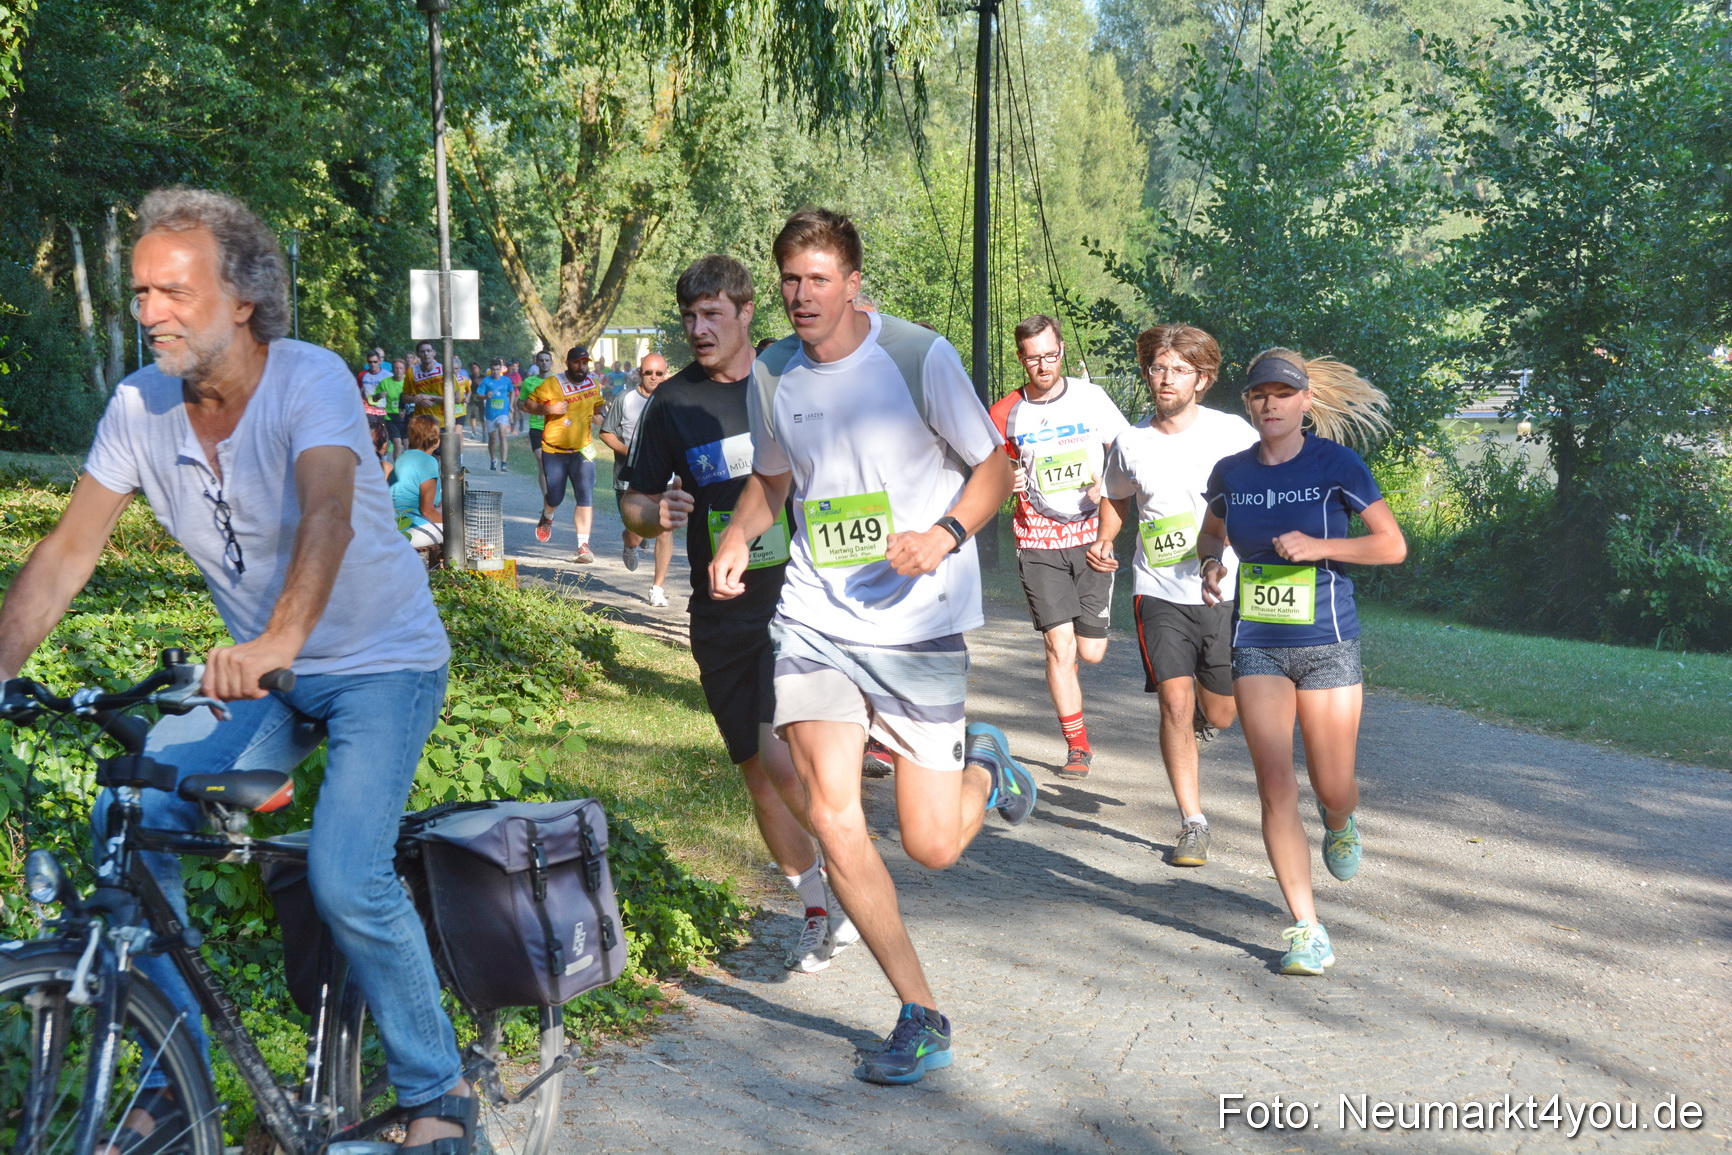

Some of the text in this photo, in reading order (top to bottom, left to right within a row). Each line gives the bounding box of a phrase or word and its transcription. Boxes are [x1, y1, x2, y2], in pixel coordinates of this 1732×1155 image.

[1045, 463, 1082, 483] 1747
[1231, 487, 1321, 505] EURO POLES
[818, 517, 882, 548] 1149
[1154, 531, 1186, 553] 443
[753, 550, 774, 559] Eugen
[829, 543, 877, 555] Hartwig Daniel
[1254, 585, 1296, 607] 504
[1277, 606, 1300, 614] Kathrin
